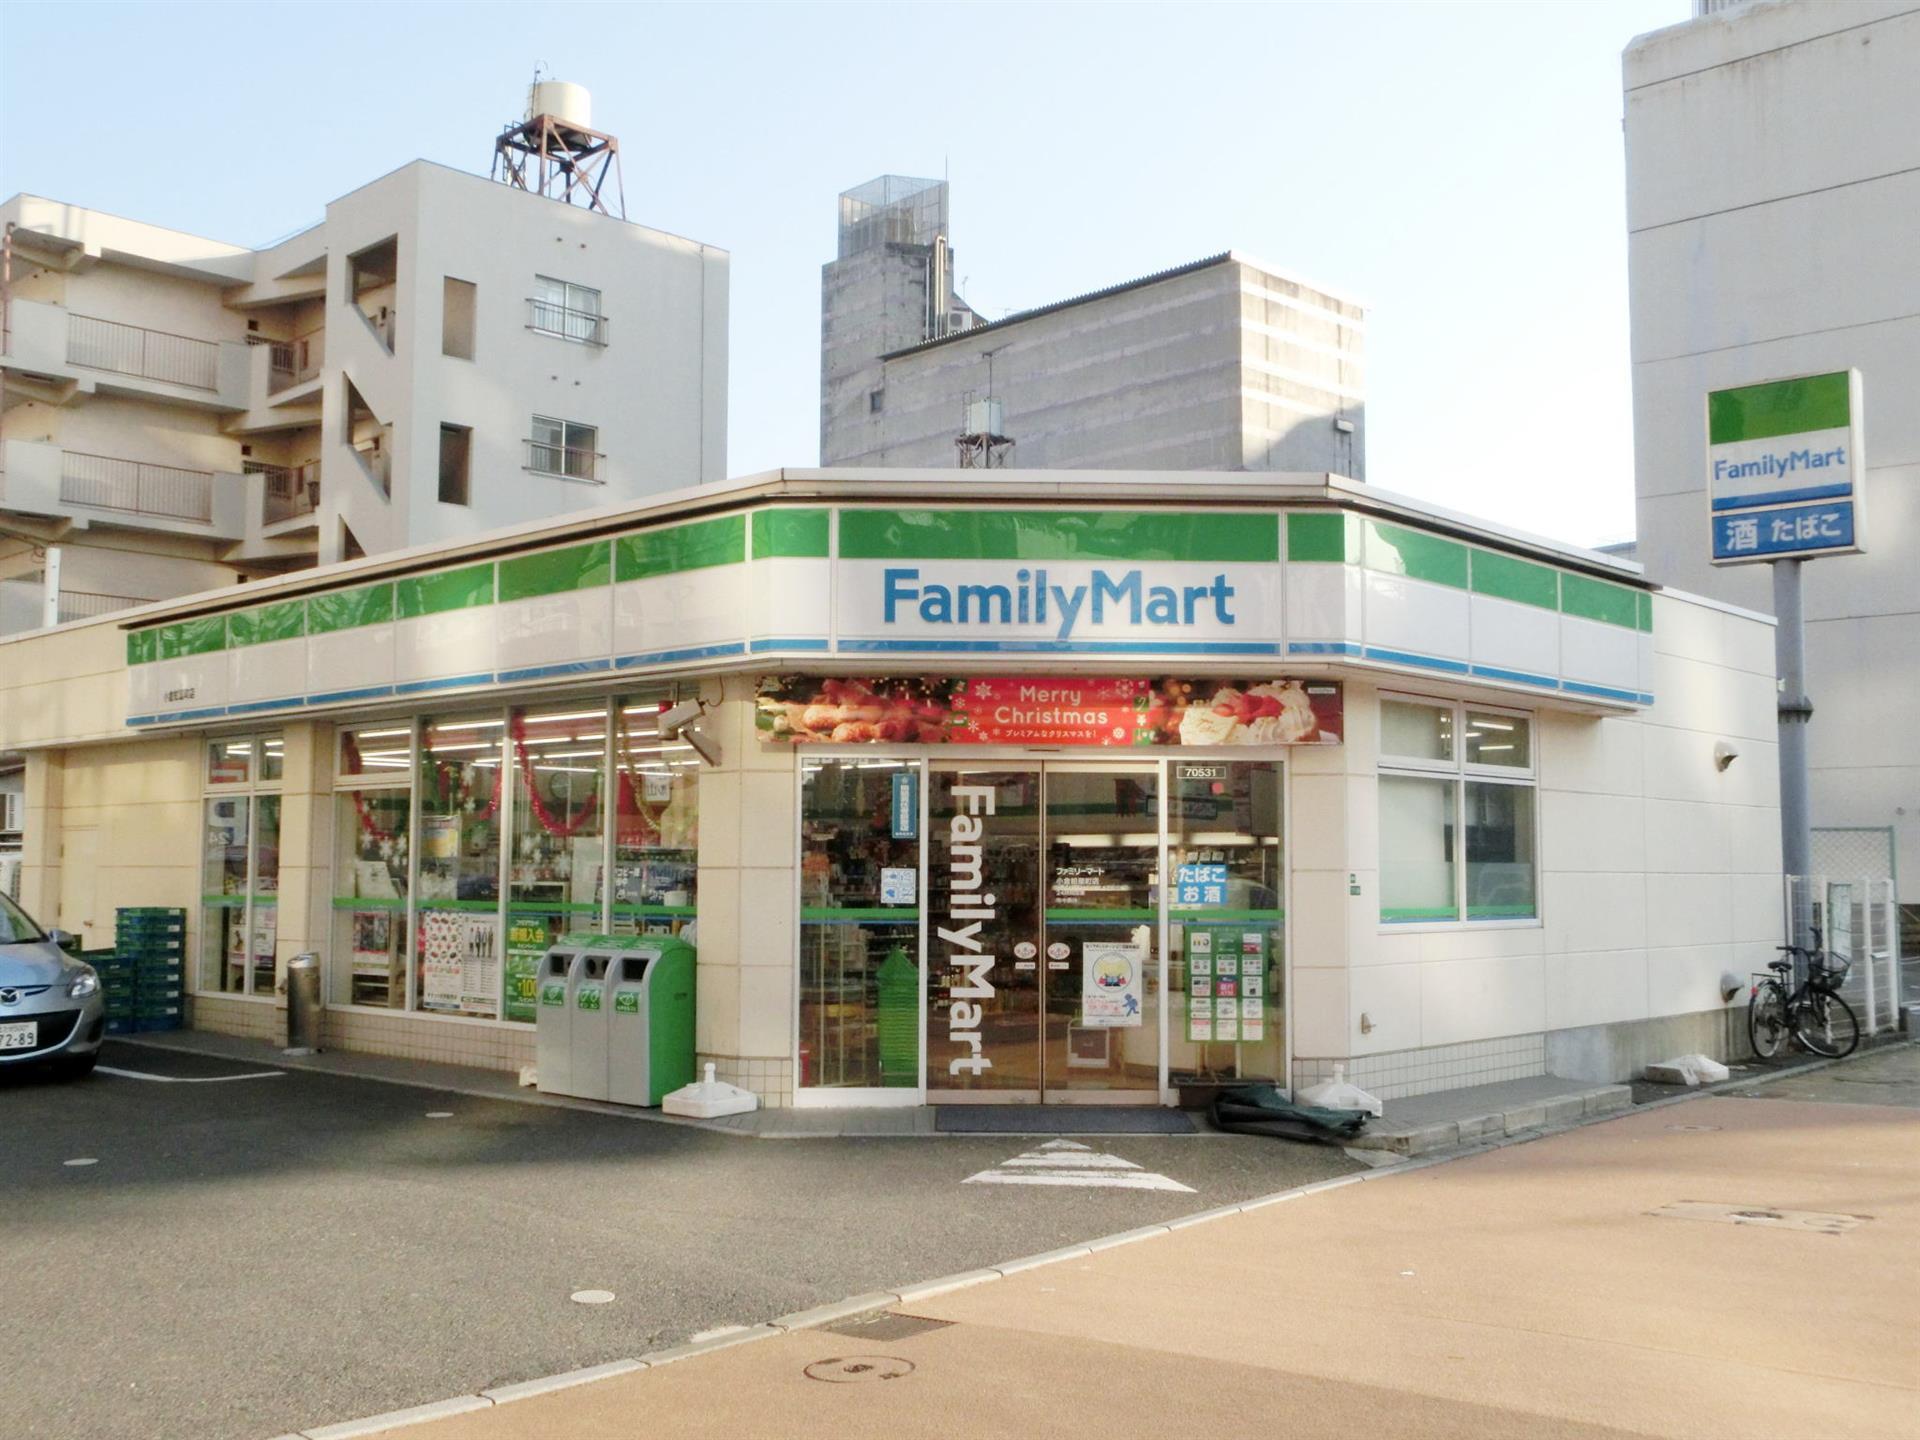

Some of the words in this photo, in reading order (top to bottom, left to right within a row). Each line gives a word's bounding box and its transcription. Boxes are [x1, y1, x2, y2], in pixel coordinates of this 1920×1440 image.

[1714, 447, 1846, 480] FamilyMart
[1726, 518, 1758, 551] 酒
[1772, 513, 1842, 543] たばこ
[884, 568, 1235, 642] FamilyMart
[1020, 685, 1081, 706] Merry
[994, 706, 1108, 724] Christmas
[1185, 768, 1217, 777] 70531
[1056, 867, 1105, 876] ファミリーマート
[1178, 866, 1226, 883] たばこ
[1183, 885, 1221, 903] お酒
[937, 786, 996, 1076] FamilyMart
